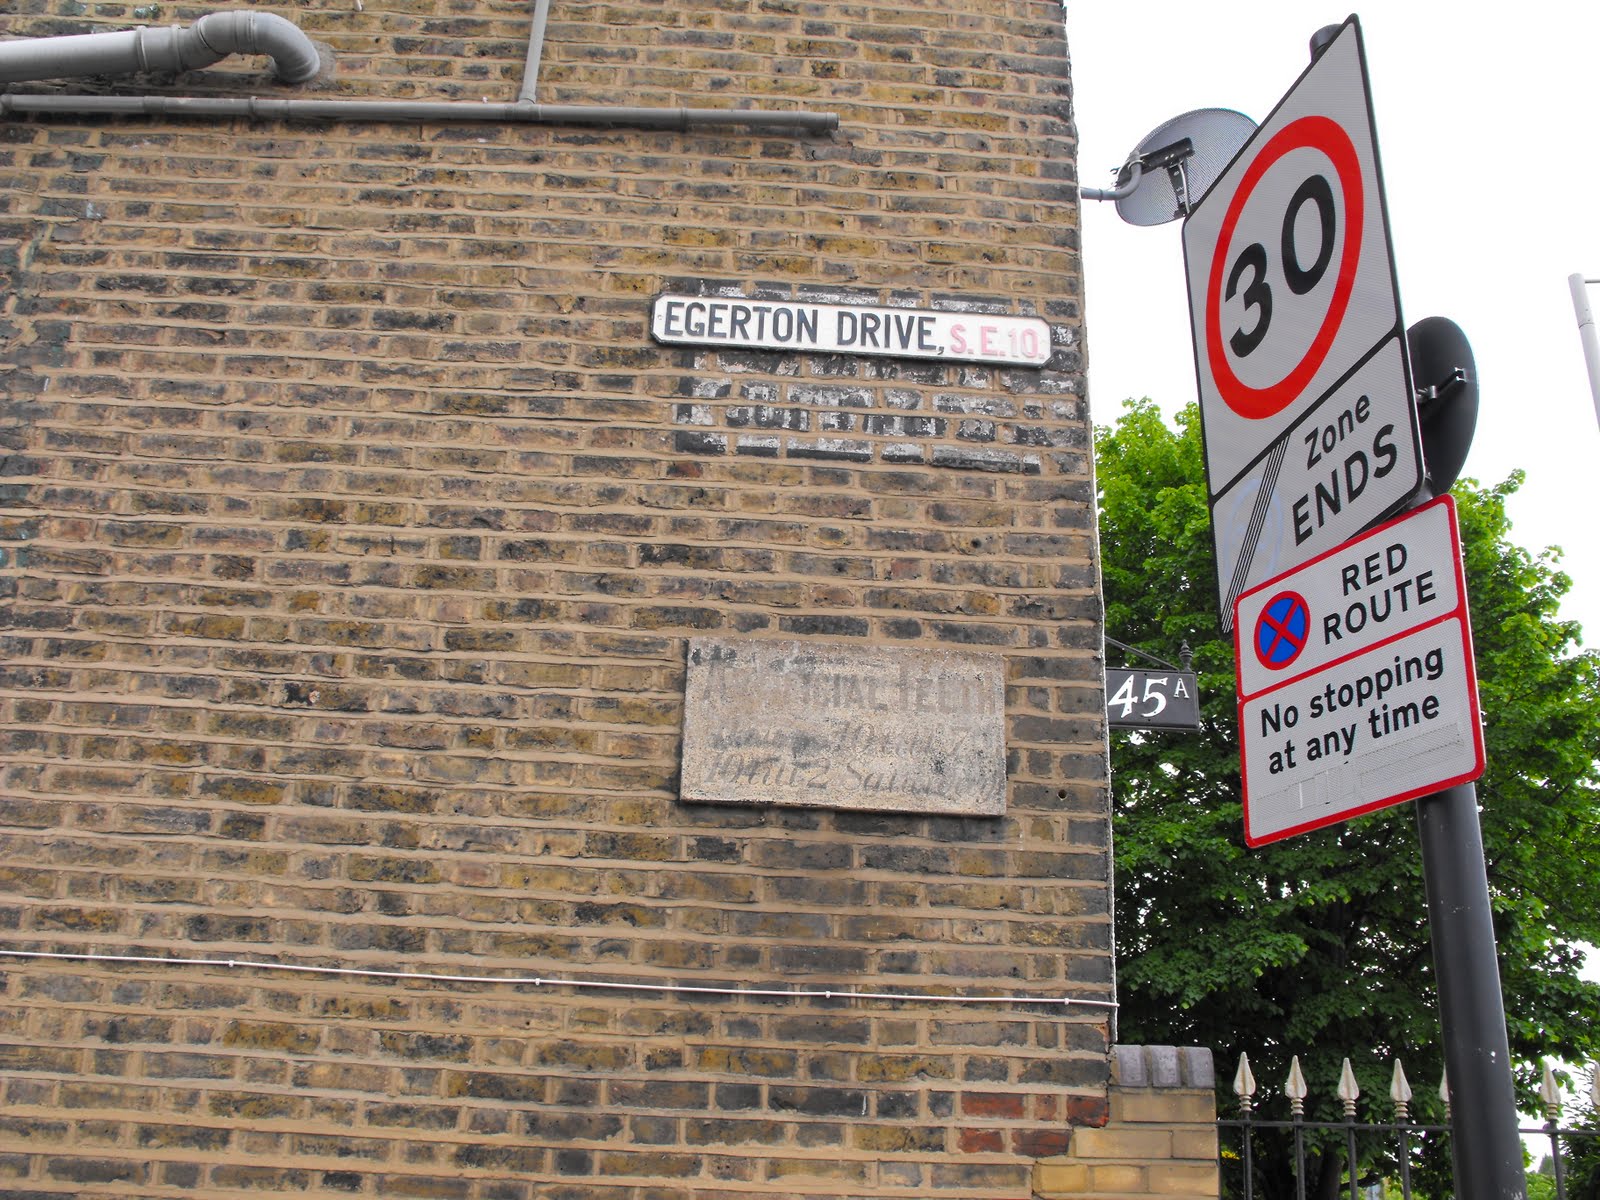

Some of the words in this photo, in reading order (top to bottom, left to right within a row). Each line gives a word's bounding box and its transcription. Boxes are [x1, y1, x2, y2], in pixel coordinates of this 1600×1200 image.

[1225, 174, 1336, 358] 30
[664, 301, 818, 343] EGERTON
[837, 310, 945, 356] DRIVE,
[1304, 394, 1370, 471] Zone
[1292, 423, 1398, 547] ENDS
[1323, 570, 1437, 645] ROUTE
[1341, 543, 1408, 596] RED
[1260, 703, 1299, 737] No
[1309, 647, 1444, 719] stopping
[1269, 738, 1296, 774] at
[1306, 723, 1357, 756] any
[1368, 694, 1440, 738] time
